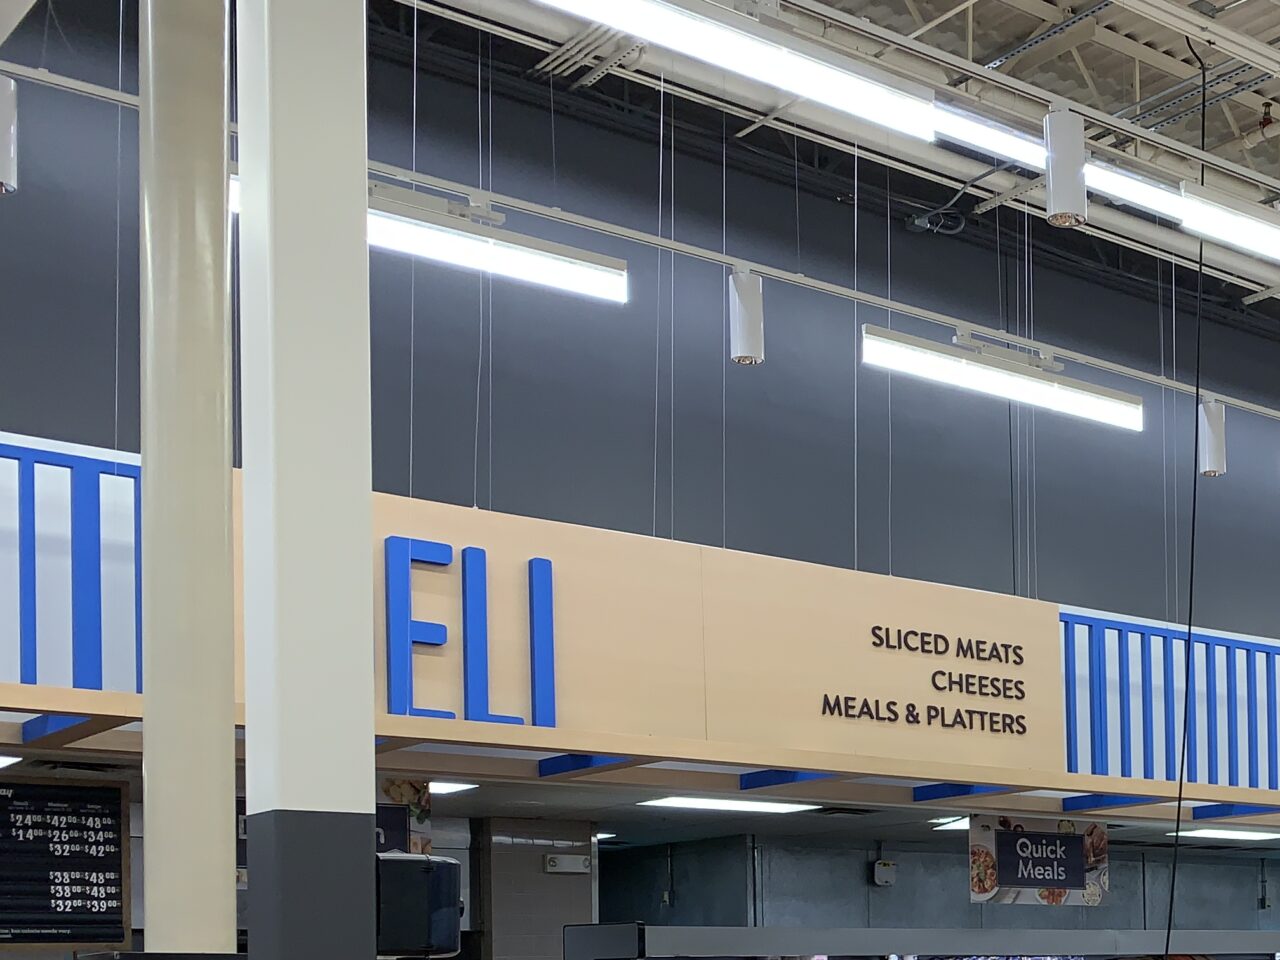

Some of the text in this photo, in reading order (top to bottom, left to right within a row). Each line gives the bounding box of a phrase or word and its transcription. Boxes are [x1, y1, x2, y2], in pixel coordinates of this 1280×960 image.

[384, 535, 556, 728] ELI
[871, 625, 1024, 665] SLICED MEATS
[931, 670, 1026, 700] CHEESES
[821, 693, 1027, 735] MEALS & PLATTERS
[1016, 838, 1067, 859] Quick
[1018, 860, 1066, 880] Meals
